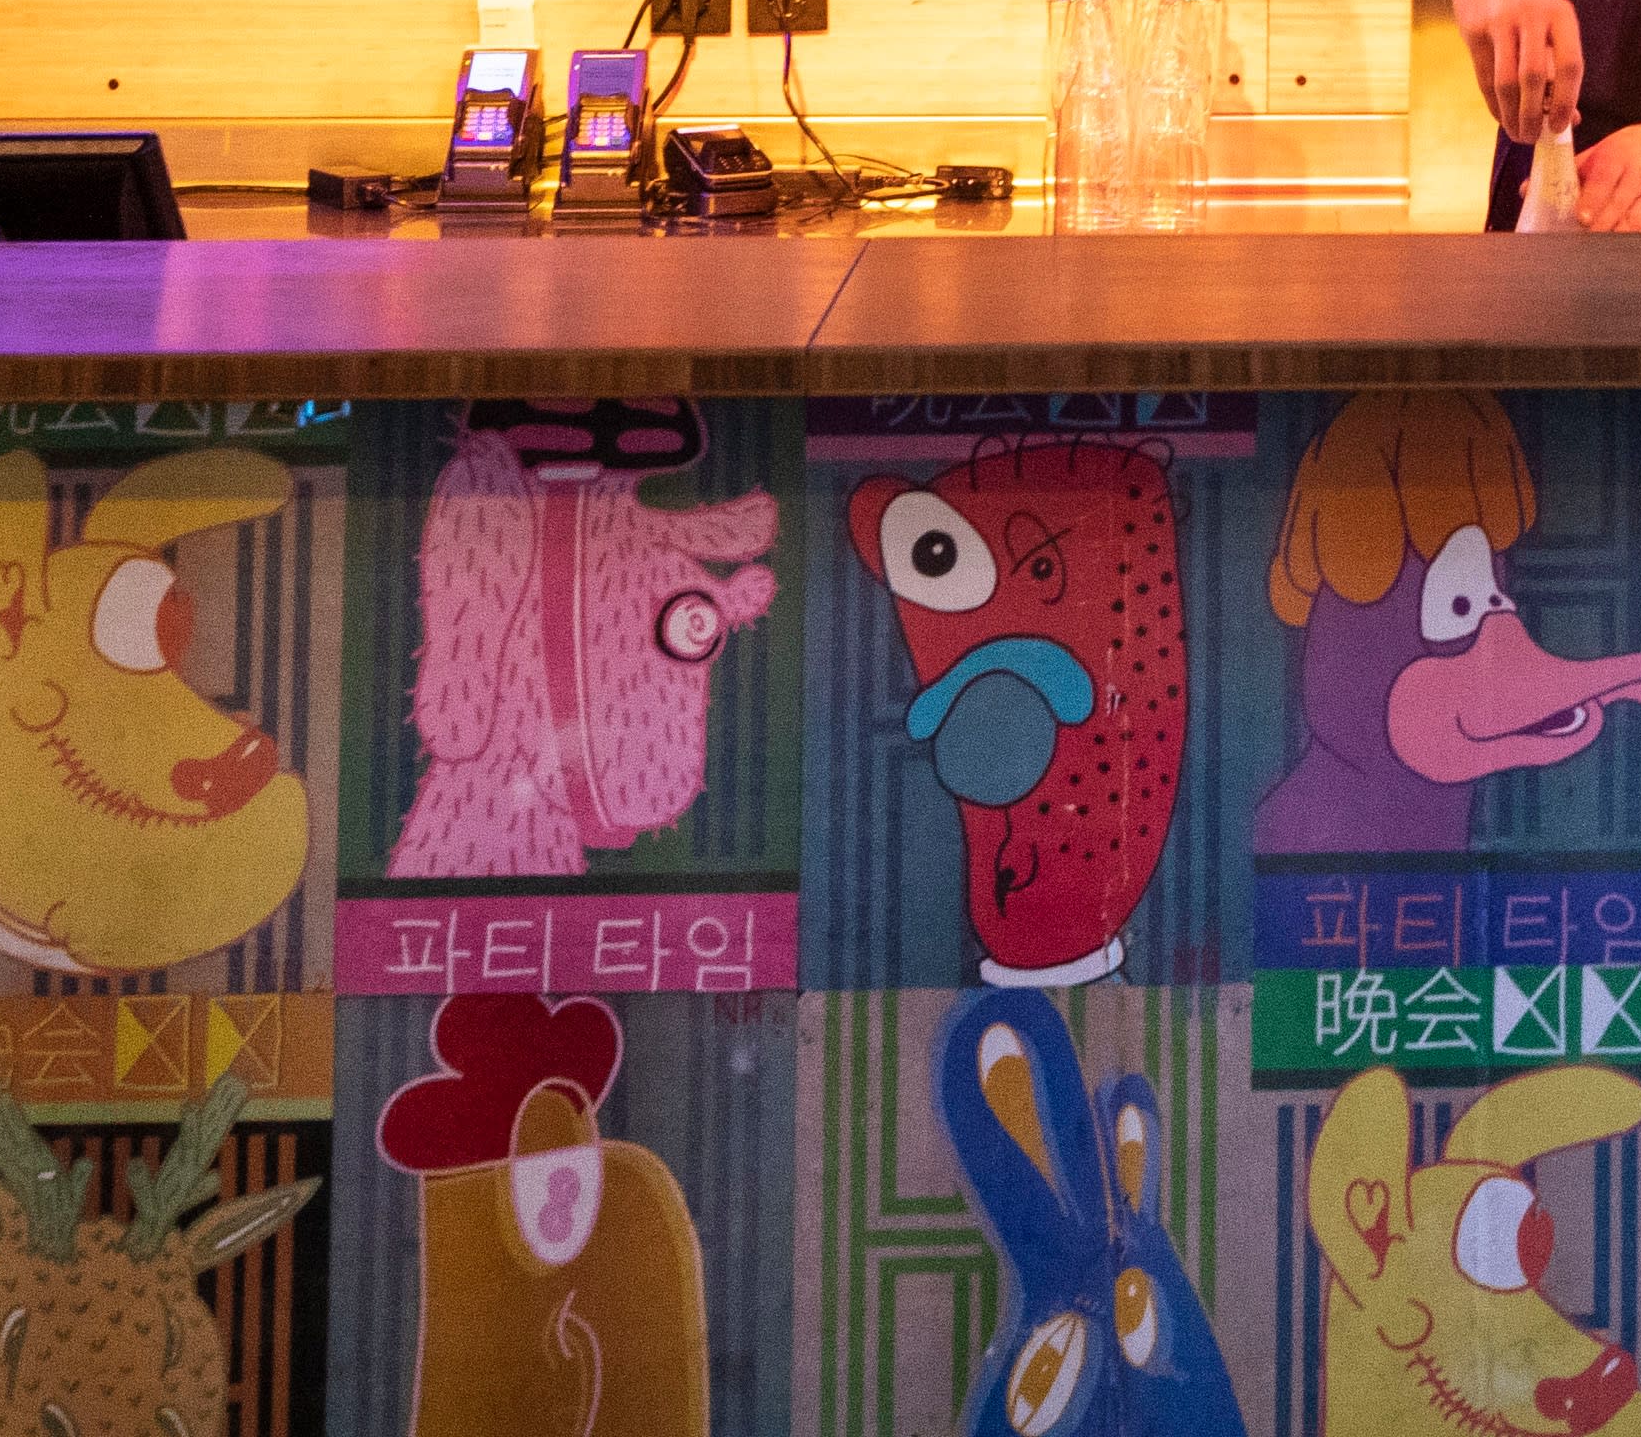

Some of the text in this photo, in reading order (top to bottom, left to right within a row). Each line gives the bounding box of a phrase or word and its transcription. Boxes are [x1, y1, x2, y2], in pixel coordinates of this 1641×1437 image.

[383, 908, 755, 994] 파티 타임
[1300, 883, 1463, 970] 파티
